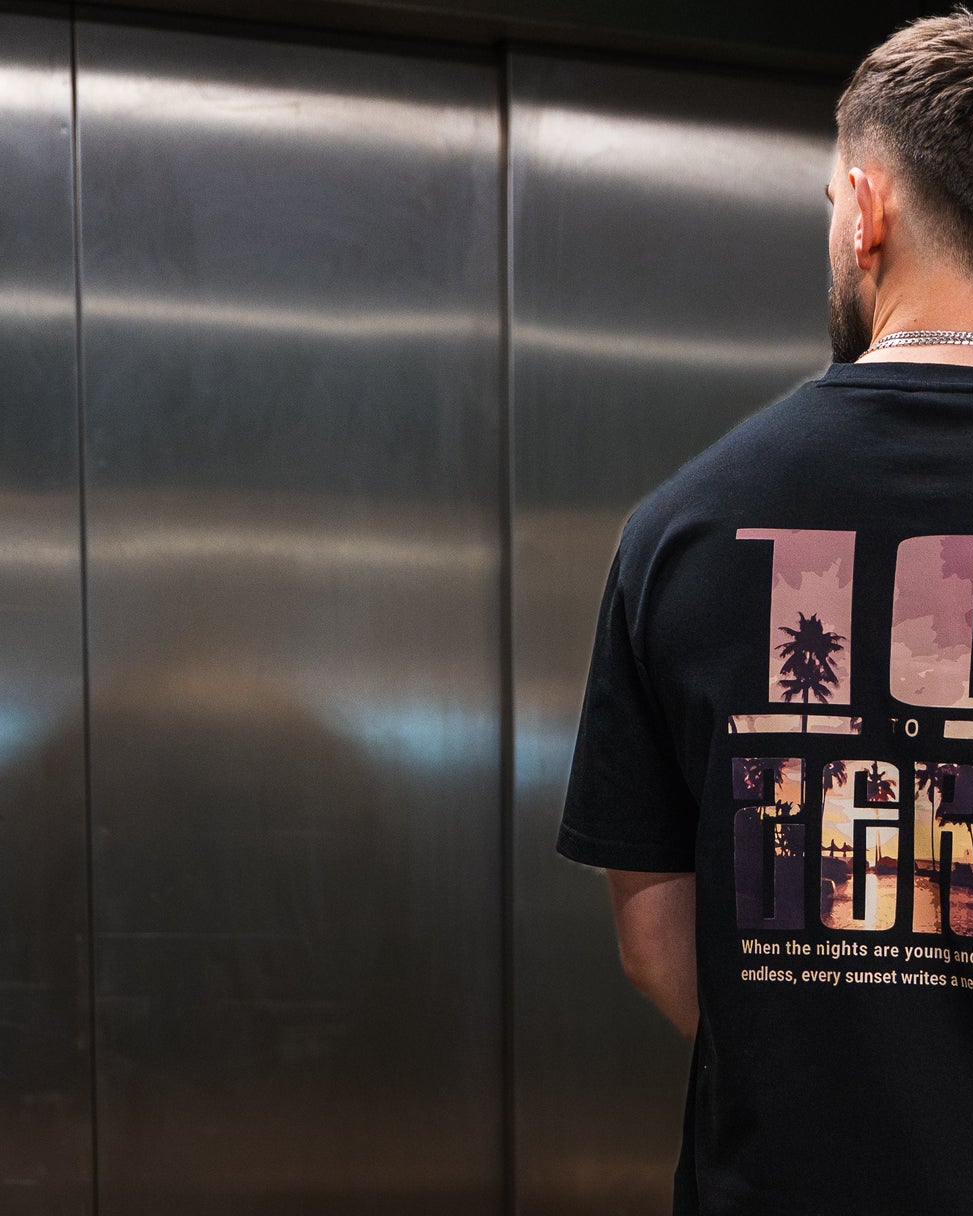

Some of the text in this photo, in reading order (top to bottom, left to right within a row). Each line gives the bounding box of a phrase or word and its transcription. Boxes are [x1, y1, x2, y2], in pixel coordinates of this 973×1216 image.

[741, 938, 780, 955] When
[786, 939, 811, 955] the
[816, 940, 868, 959] nights
[873, 945, 900, 957] are
[904, 945, 951, 963] young
[741, 966, 797, 985] endless,
[801, 970, 841, 986] every
[845, 970, 897, 984] sunset
[901, 970, 947, 986] writes
[950, 974, 959, 987] a
